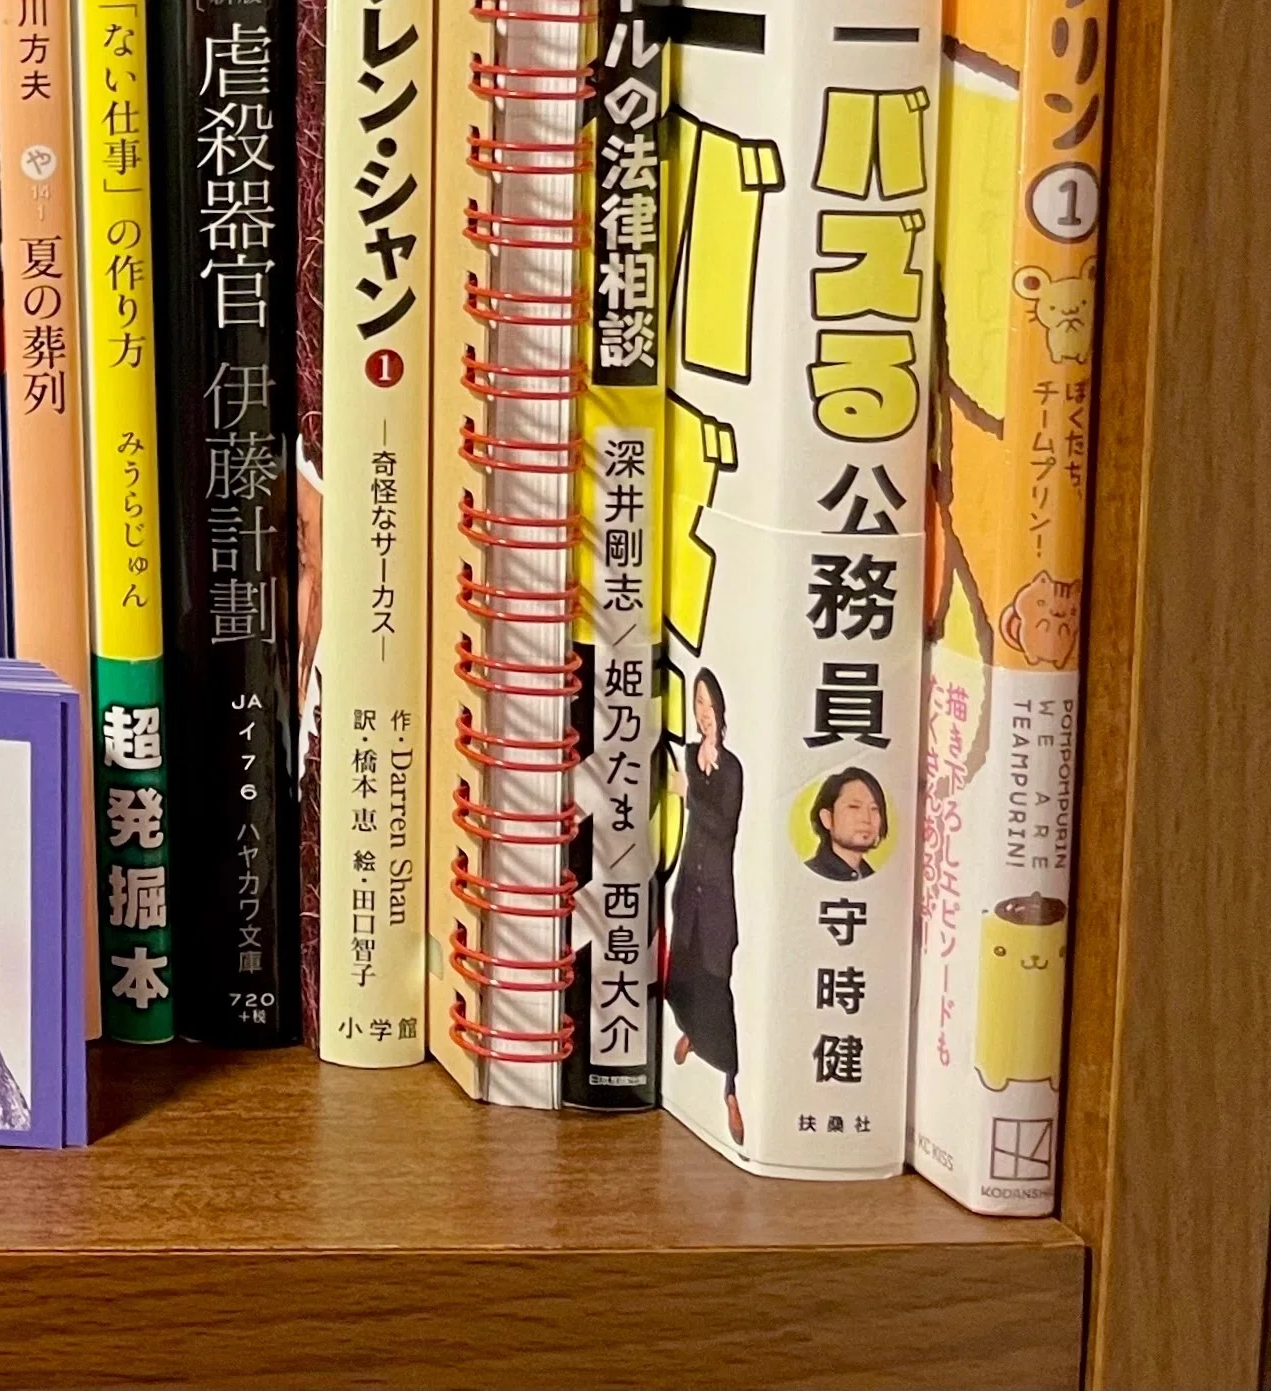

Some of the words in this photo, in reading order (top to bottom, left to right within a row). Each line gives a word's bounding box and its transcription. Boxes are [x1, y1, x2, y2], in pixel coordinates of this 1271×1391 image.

[25, 149, 53, 176] や
[29, 184, 52, 201] 14
[99, 0, 148, 371] 「ない仕事」の作り方
[197, 23, 277, 331] 虐殺器官
[18, 234, 67, 417] 夏の葬列
[116, 431, 149, 609] みうらじゅん
[203, 360, 279, 647] 伊藤計劃
[1029, 380, 1060, 558] チームプリン!
[1005, 699, 1032, 868] TEAMPURIN!
[1037, 700, 1056, 747] WE
[1054, 699, 1074, 870] POMPOMPURIN
[102, 706, 170, 1010] 超発掘本
[237, 823, 263, 975] ハヤカワ文庫
[389, 859, 413, 927] Shan
[1031, 791, 1051, 870] ARE
[229, 993, 275, 1008] 720
[338, 1017, 418, 1041] 小学館
[812, 899, 868, 1085] 守時健
[798, 1112, 872, 1134] 扶桑社
[980, 1184, 1054, 1201] KODANSH
